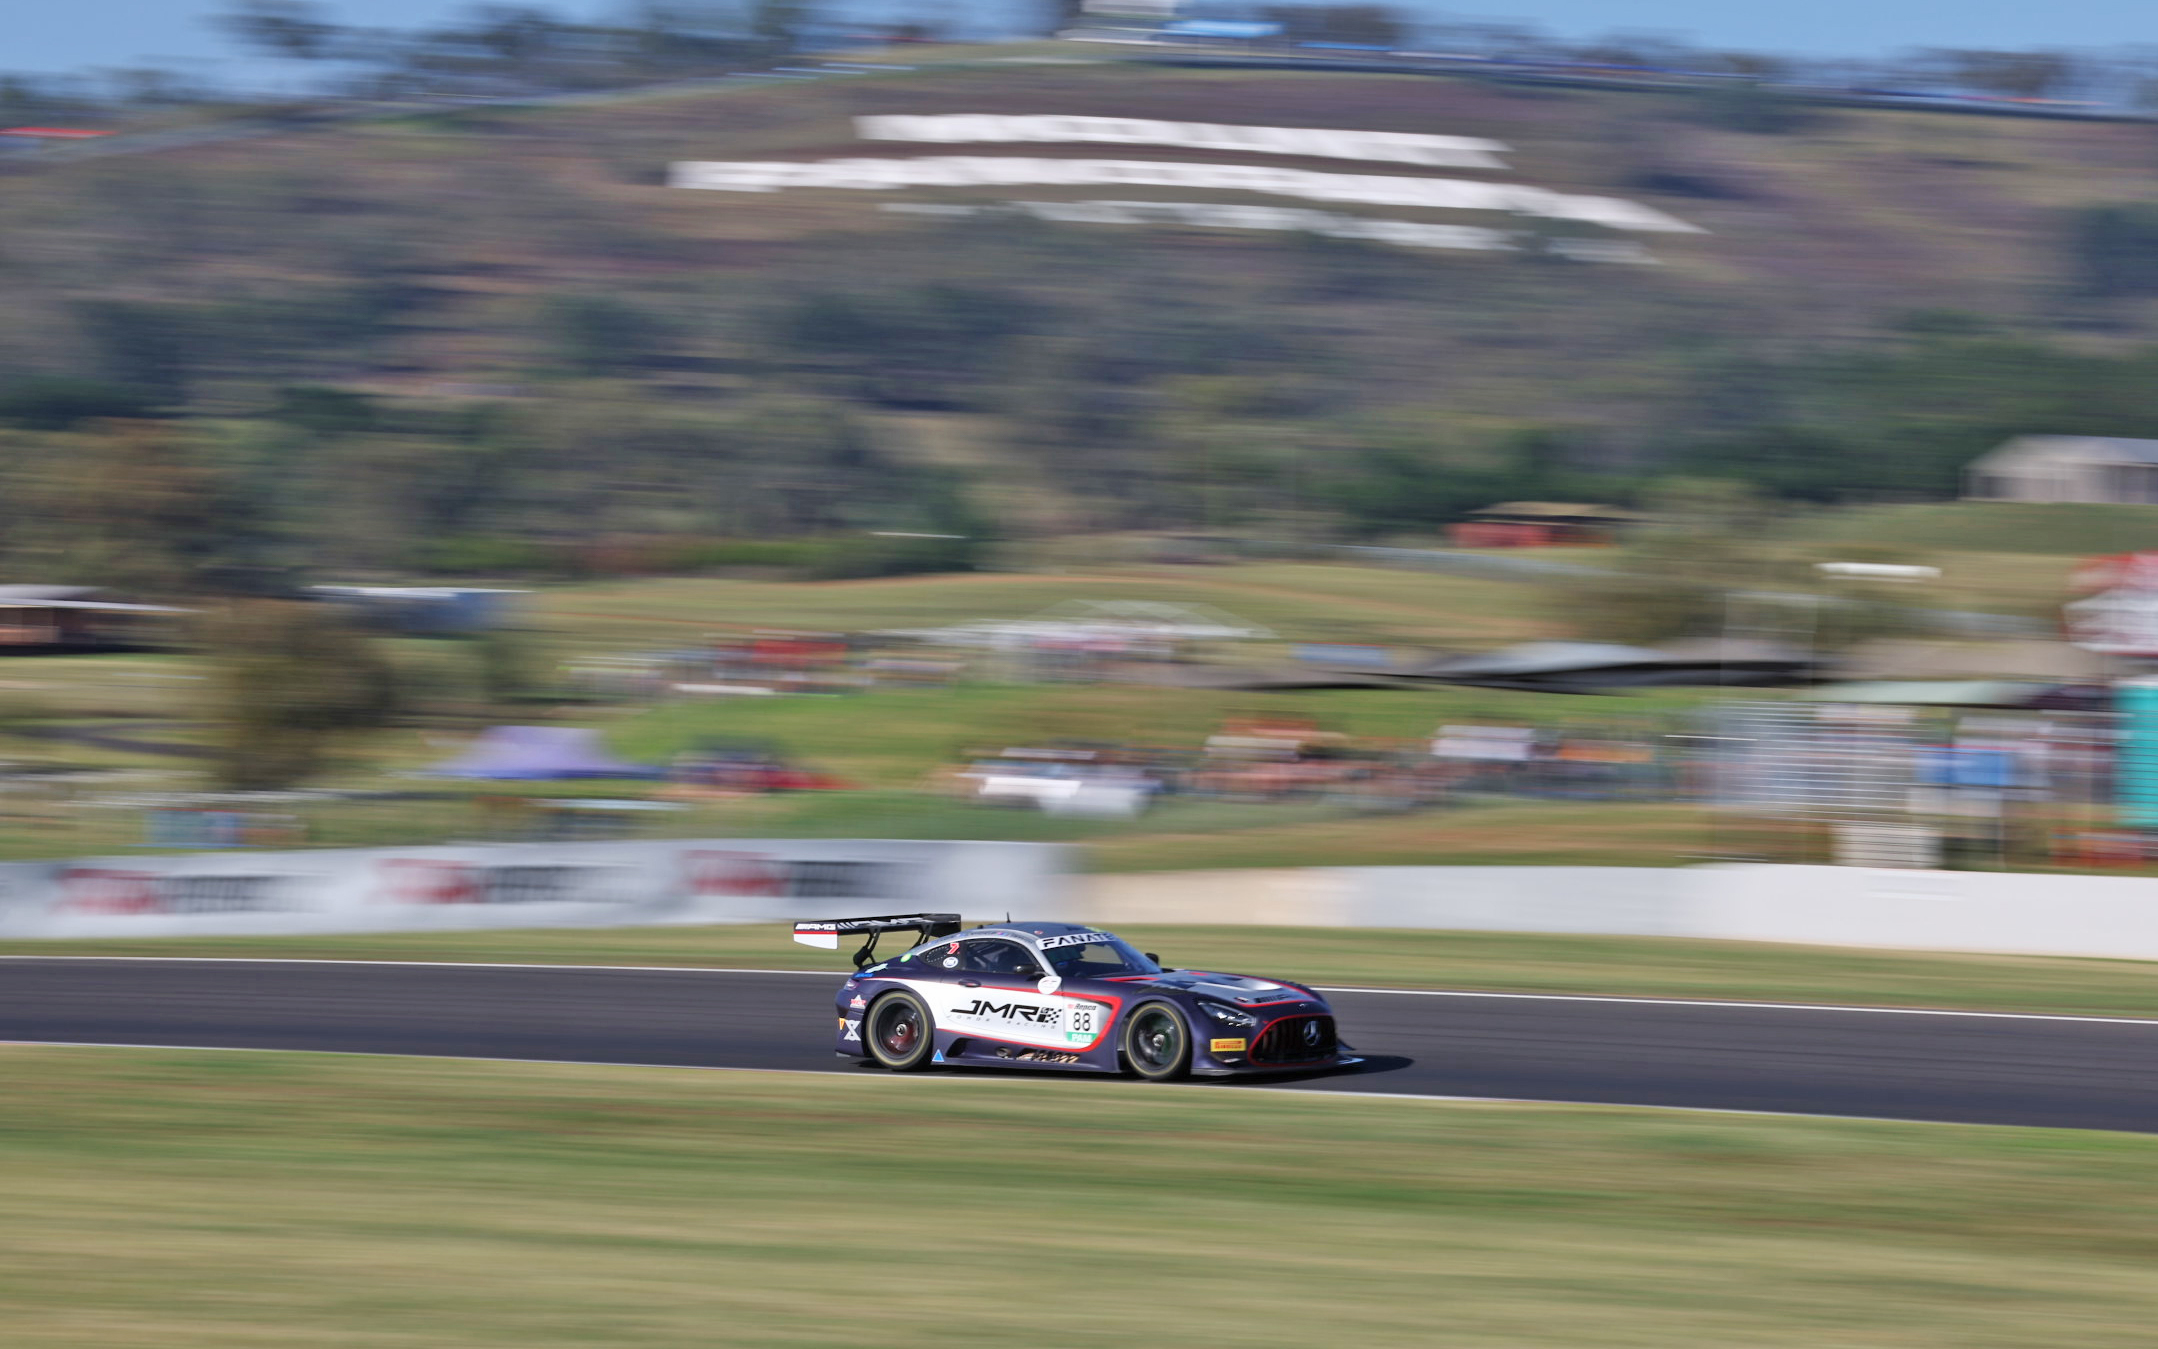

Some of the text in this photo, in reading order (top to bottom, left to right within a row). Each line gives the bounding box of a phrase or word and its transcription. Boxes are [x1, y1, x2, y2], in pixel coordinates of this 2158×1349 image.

[807, 923, 836, 931] AMG
[1042, 933, 1114, 947] FANATE
[950, 1000, 1040, 1022] JMR
[1074, 1003, 1097, 1011] Repco
[1073, 1012, 1091, 1032] 88
[1071, 1033, 1094, 1043] PAM
